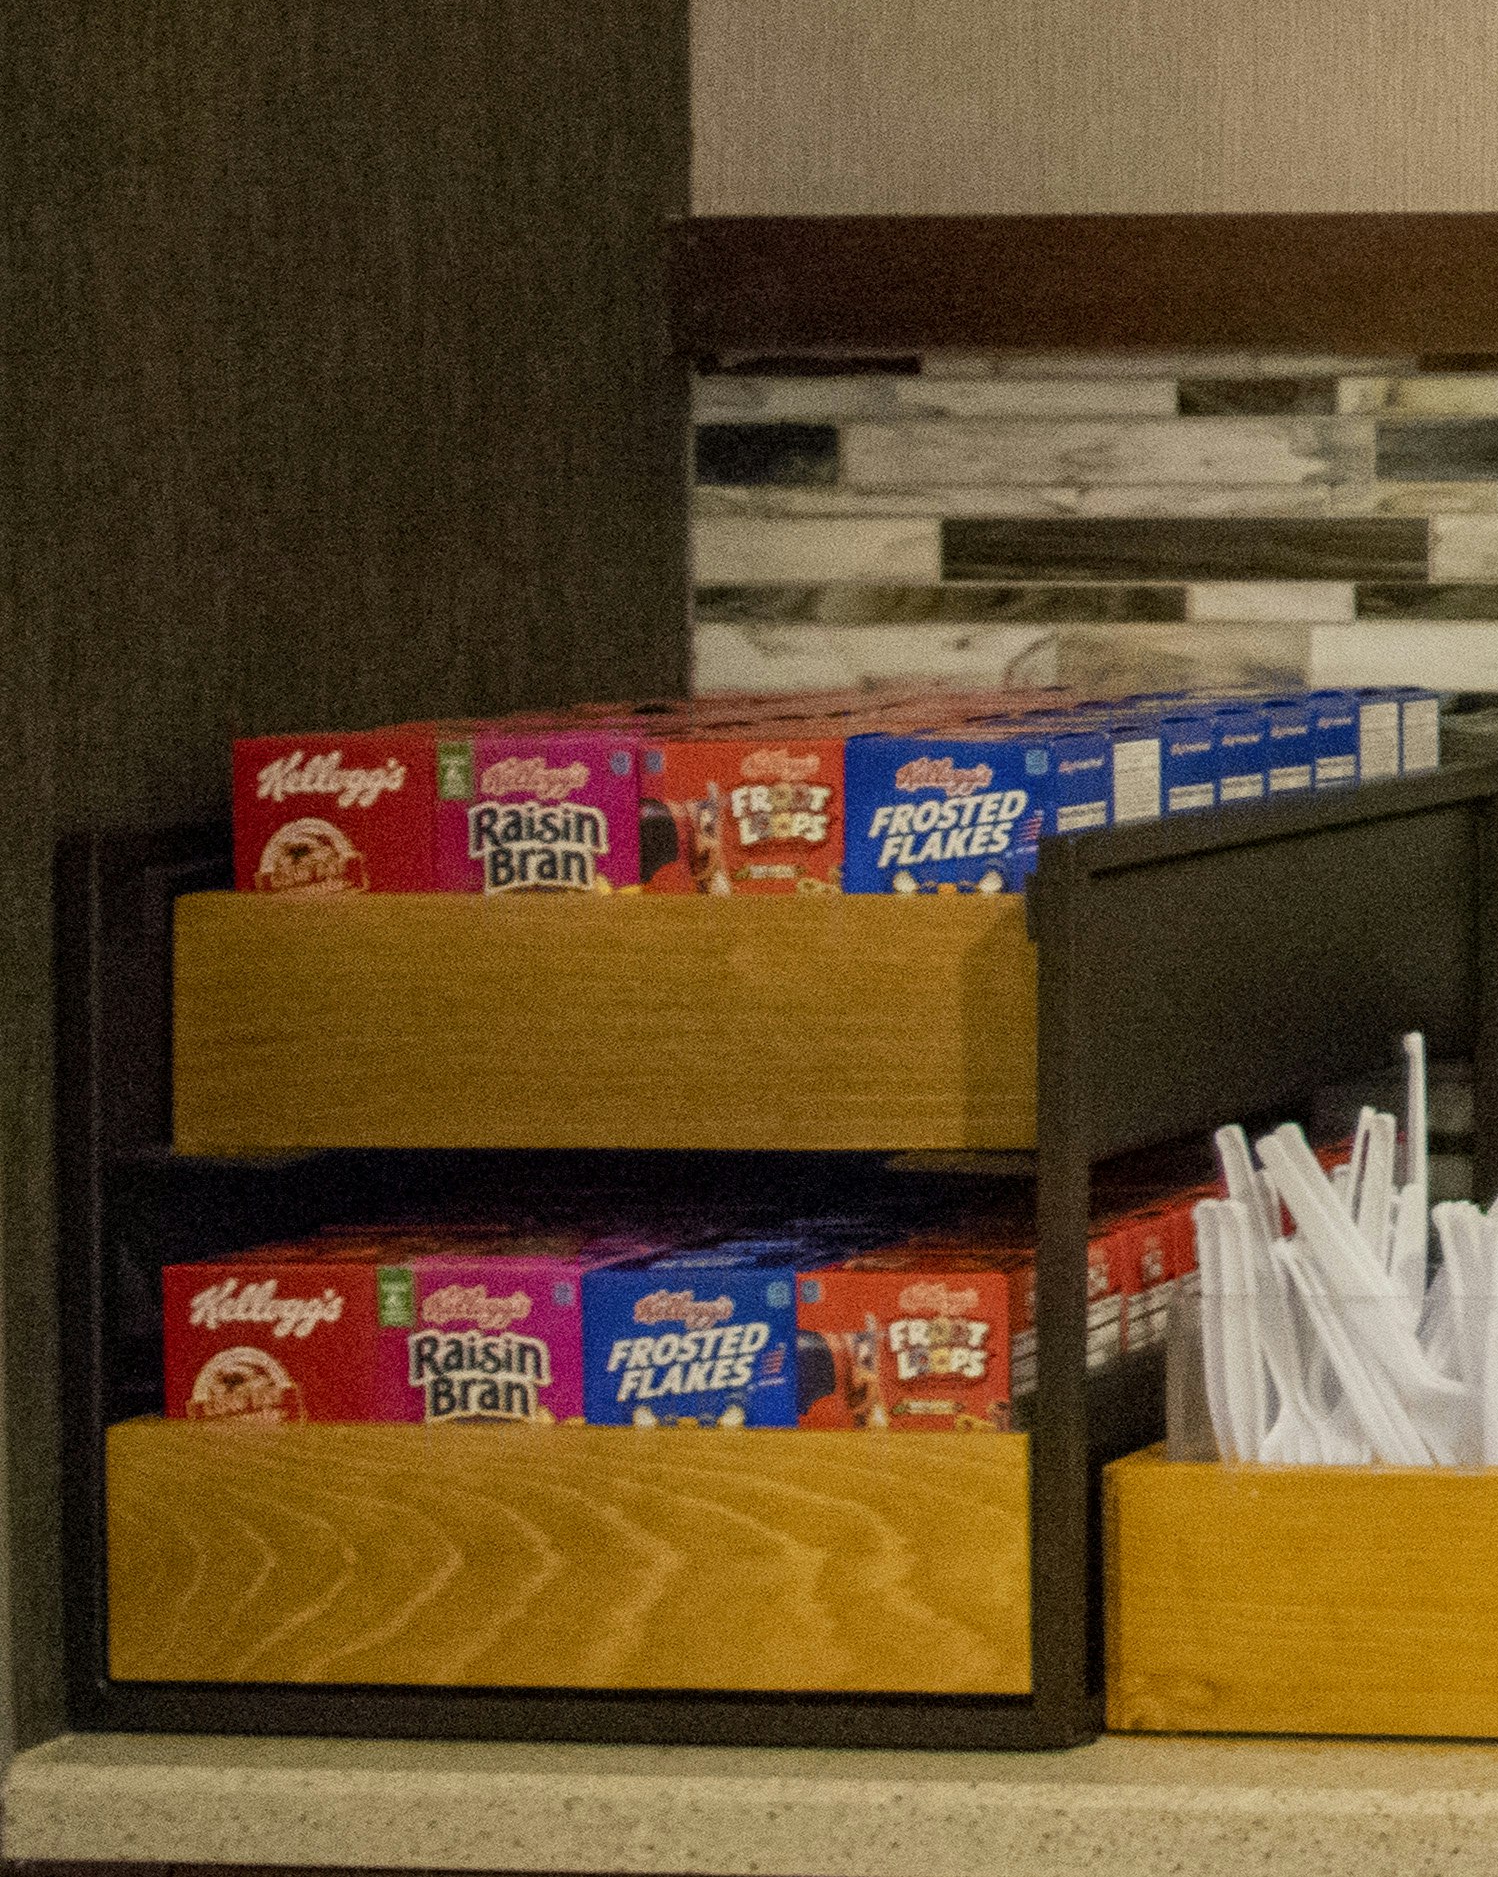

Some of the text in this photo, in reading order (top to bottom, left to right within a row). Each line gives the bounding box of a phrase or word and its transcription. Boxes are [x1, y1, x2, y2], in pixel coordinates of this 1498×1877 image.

[257, 750, 406, 808] Kellogg's
[471, 804, 604, 851] Raisin
[869, 789, 1029, 838] FROSTED
[488, 847, 588, 886] Bran
[878, 821, 1014, 868] FLAKES
[190, 1277, 344, 1338] Kellogg's
[413, 1332, 544, 1379] Raisin
[607, 1322, 770, 1371] FROSTED
[430, 1376, 531, 1416] Bran
[617, 1355, 755, 1402] FLAKES
